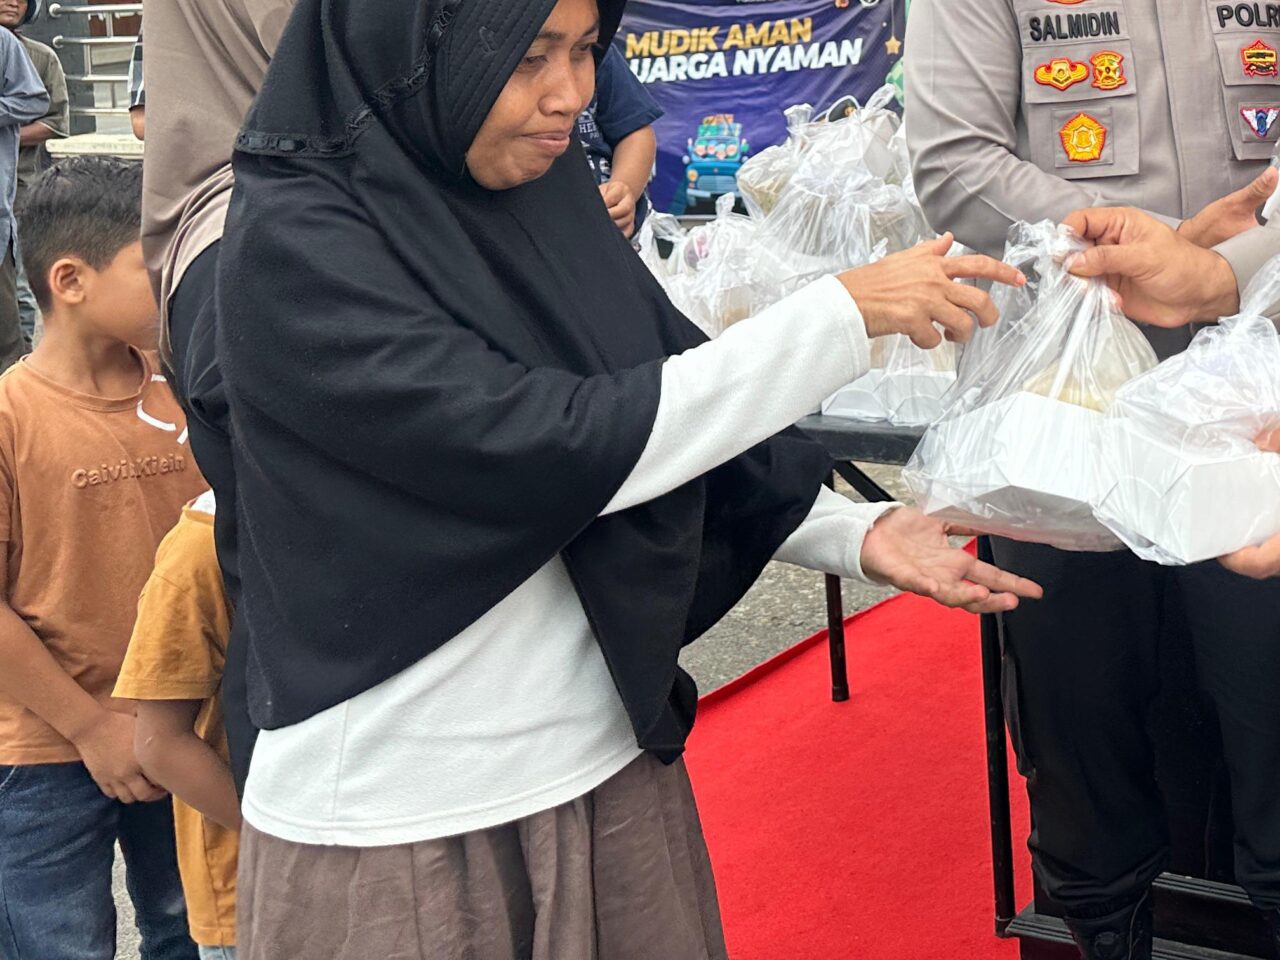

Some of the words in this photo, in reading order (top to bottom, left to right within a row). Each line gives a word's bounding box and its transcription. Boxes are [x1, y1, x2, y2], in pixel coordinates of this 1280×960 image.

[626, 26, 720, 59] MUDIK
[722, 17, 812, 49] AMAN
[1029, 10, 1120, 42] SALMIDIN
[629, 51, 728, 84] UARGA
[732, 38, 863, 75] NYAMAN
